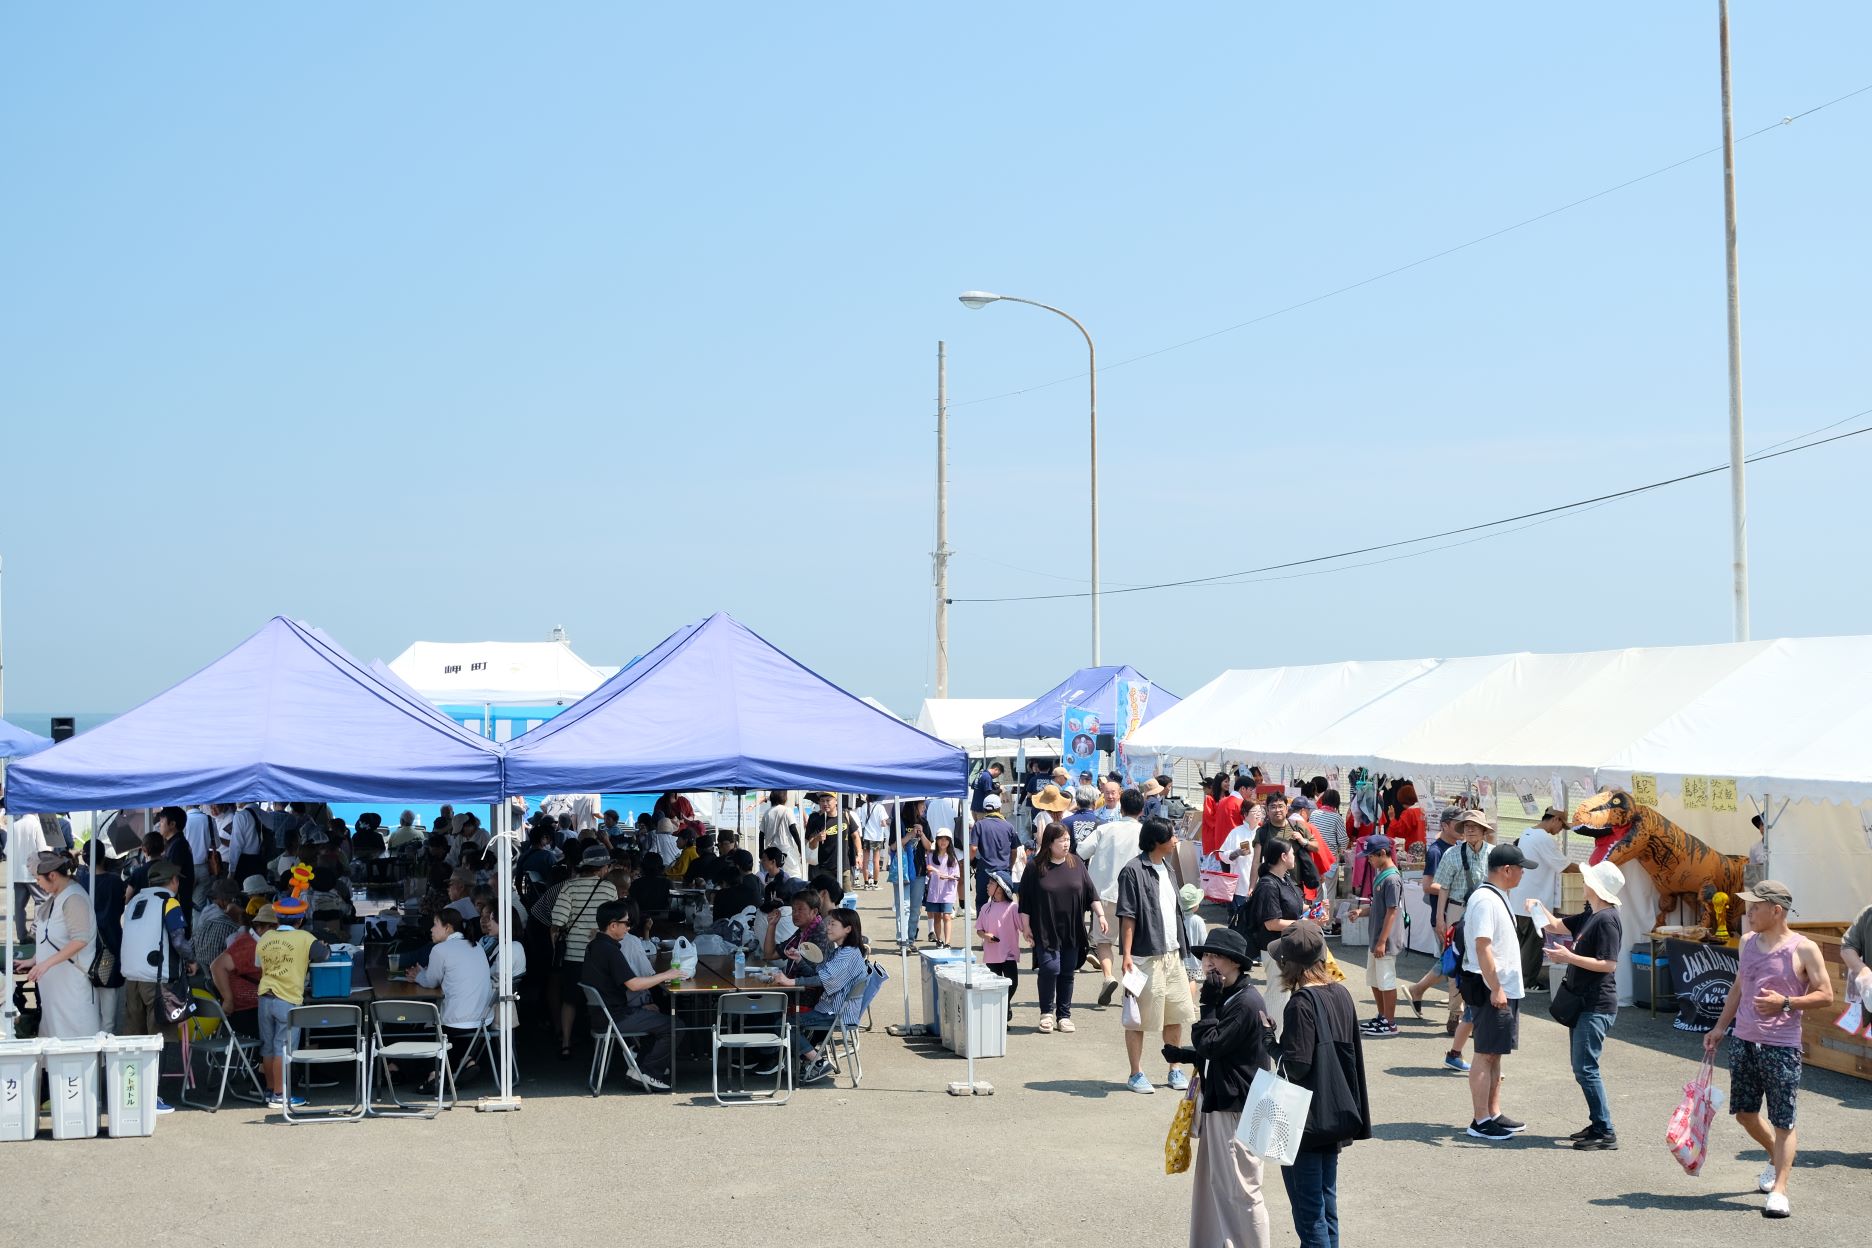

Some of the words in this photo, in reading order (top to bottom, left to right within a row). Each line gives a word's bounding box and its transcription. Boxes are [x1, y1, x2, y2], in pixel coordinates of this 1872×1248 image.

[1682, 950, 1713, 983] JACK
[1703, 944, 1740, 975] DANI
[6, 1078, 18, 1102] カン
[126, 1063, 136, 1106] ペットボトル
